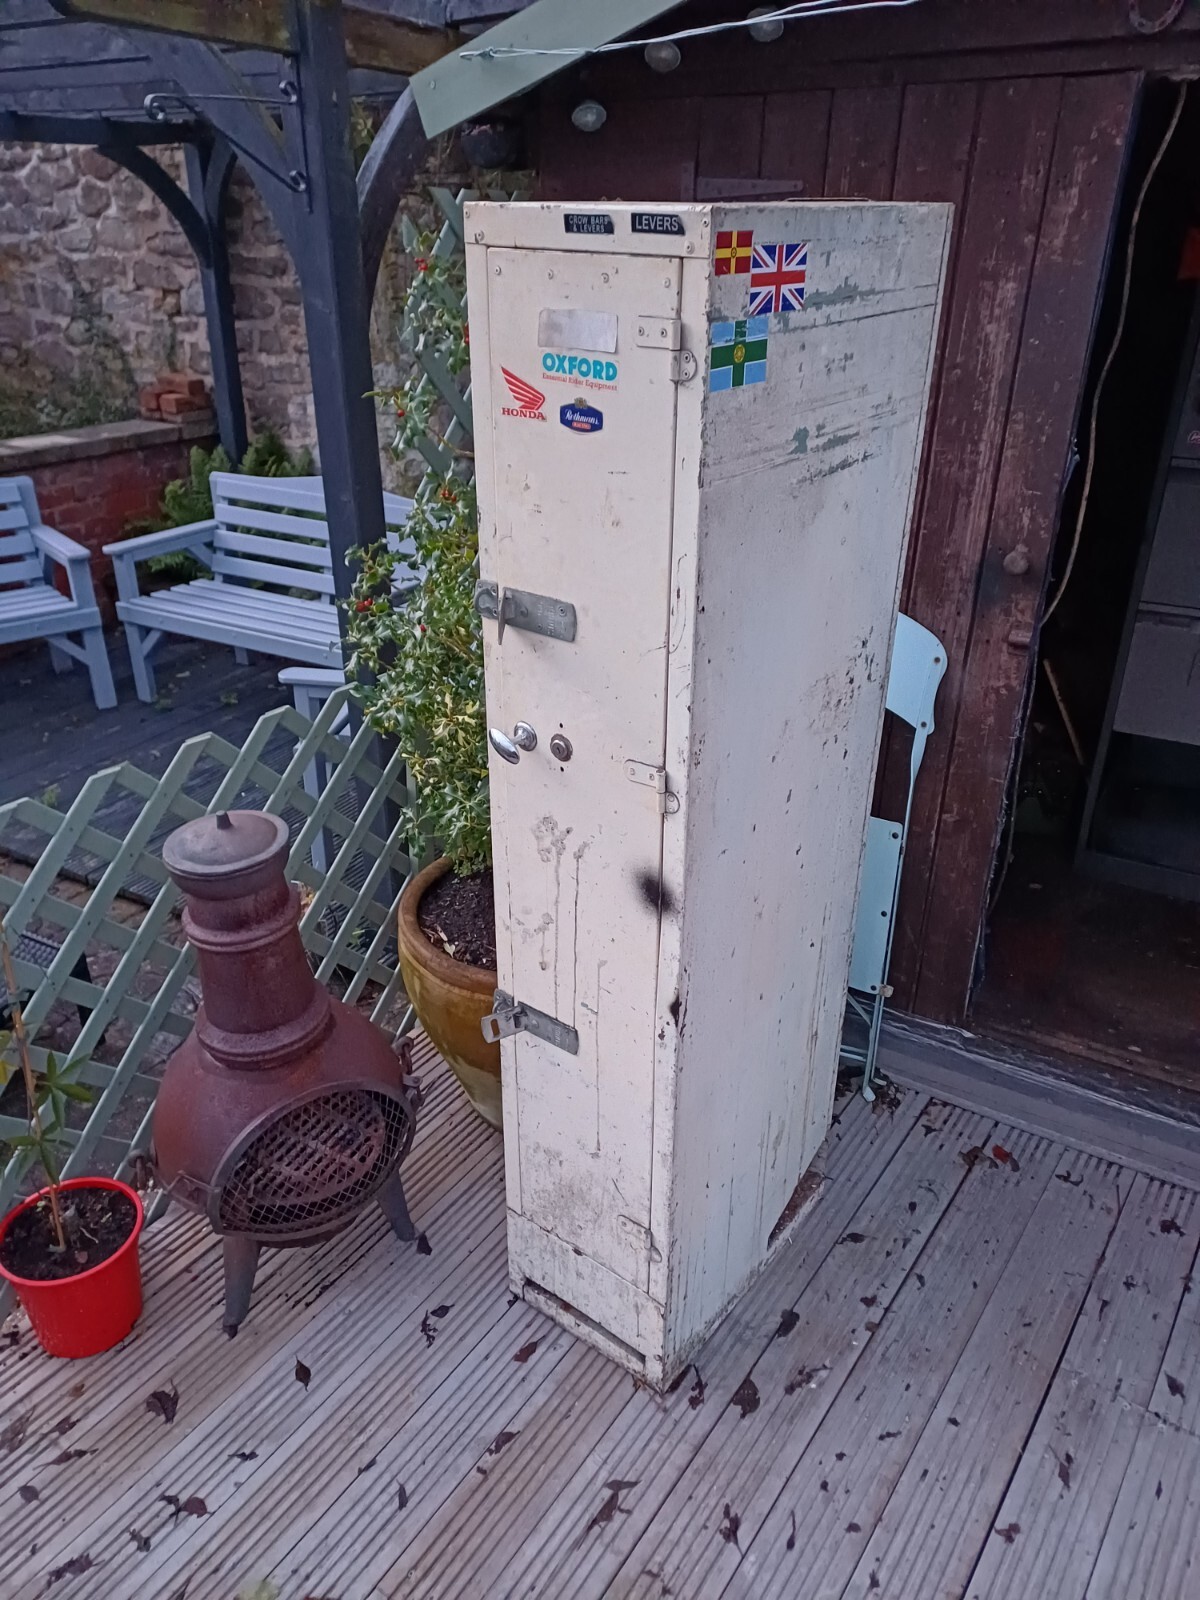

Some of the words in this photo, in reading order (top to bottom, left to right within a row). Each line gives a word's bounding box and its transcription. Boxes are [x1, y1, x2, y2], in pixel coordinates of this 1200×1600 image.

[568, 215, 588, 225] CROW
[591, 216, 609, 225] BARS
[635, 215, 679, 231] LEVERS
[580, 224, 605, 233] LEVERS
[542, 352, 618, 381] OXFORD
[585, 379, 617, 391] Equipment
[502, 408, 546, 420] HONDA
